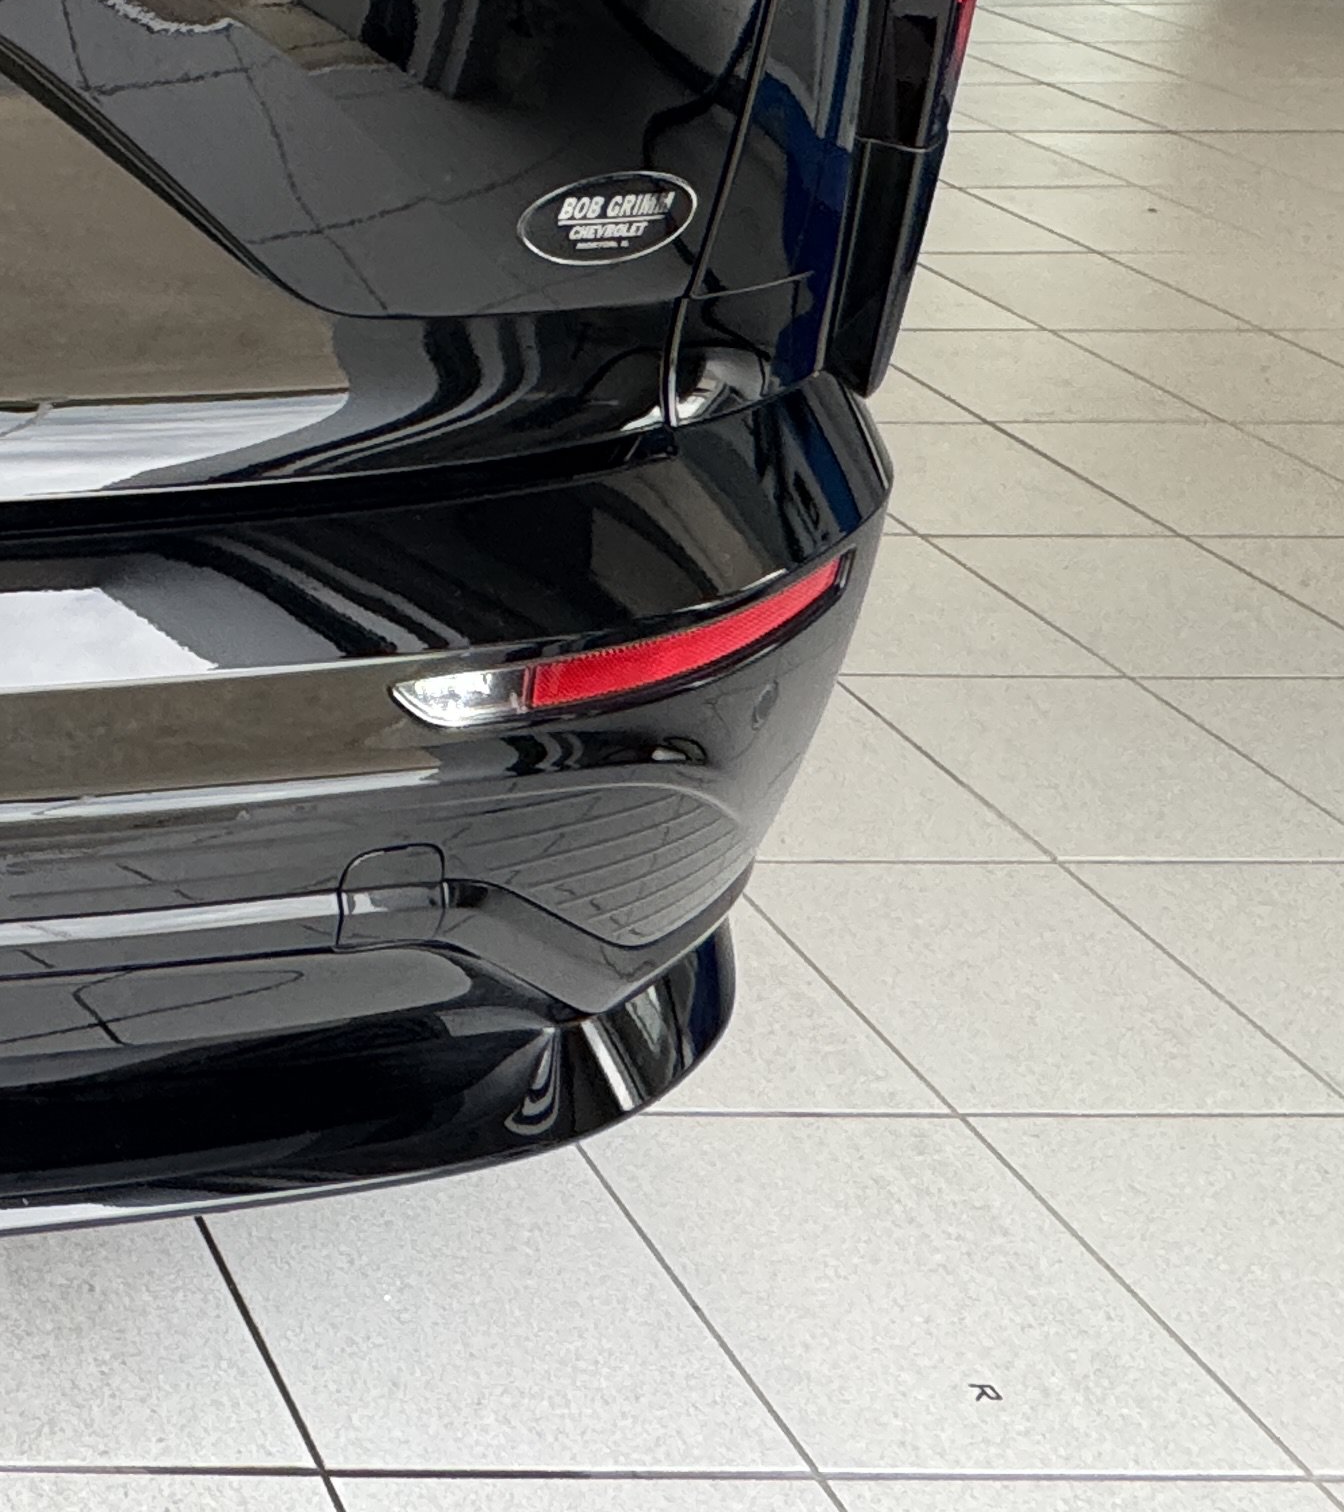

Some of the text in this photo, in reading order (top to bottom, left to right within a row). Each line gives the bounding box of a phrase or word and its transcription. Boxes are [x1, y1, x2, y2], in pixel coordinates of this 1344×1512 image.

[557, 191, 676, 220] BOB GRIMM
[569, 220, 649, 240] CHEVROLET
